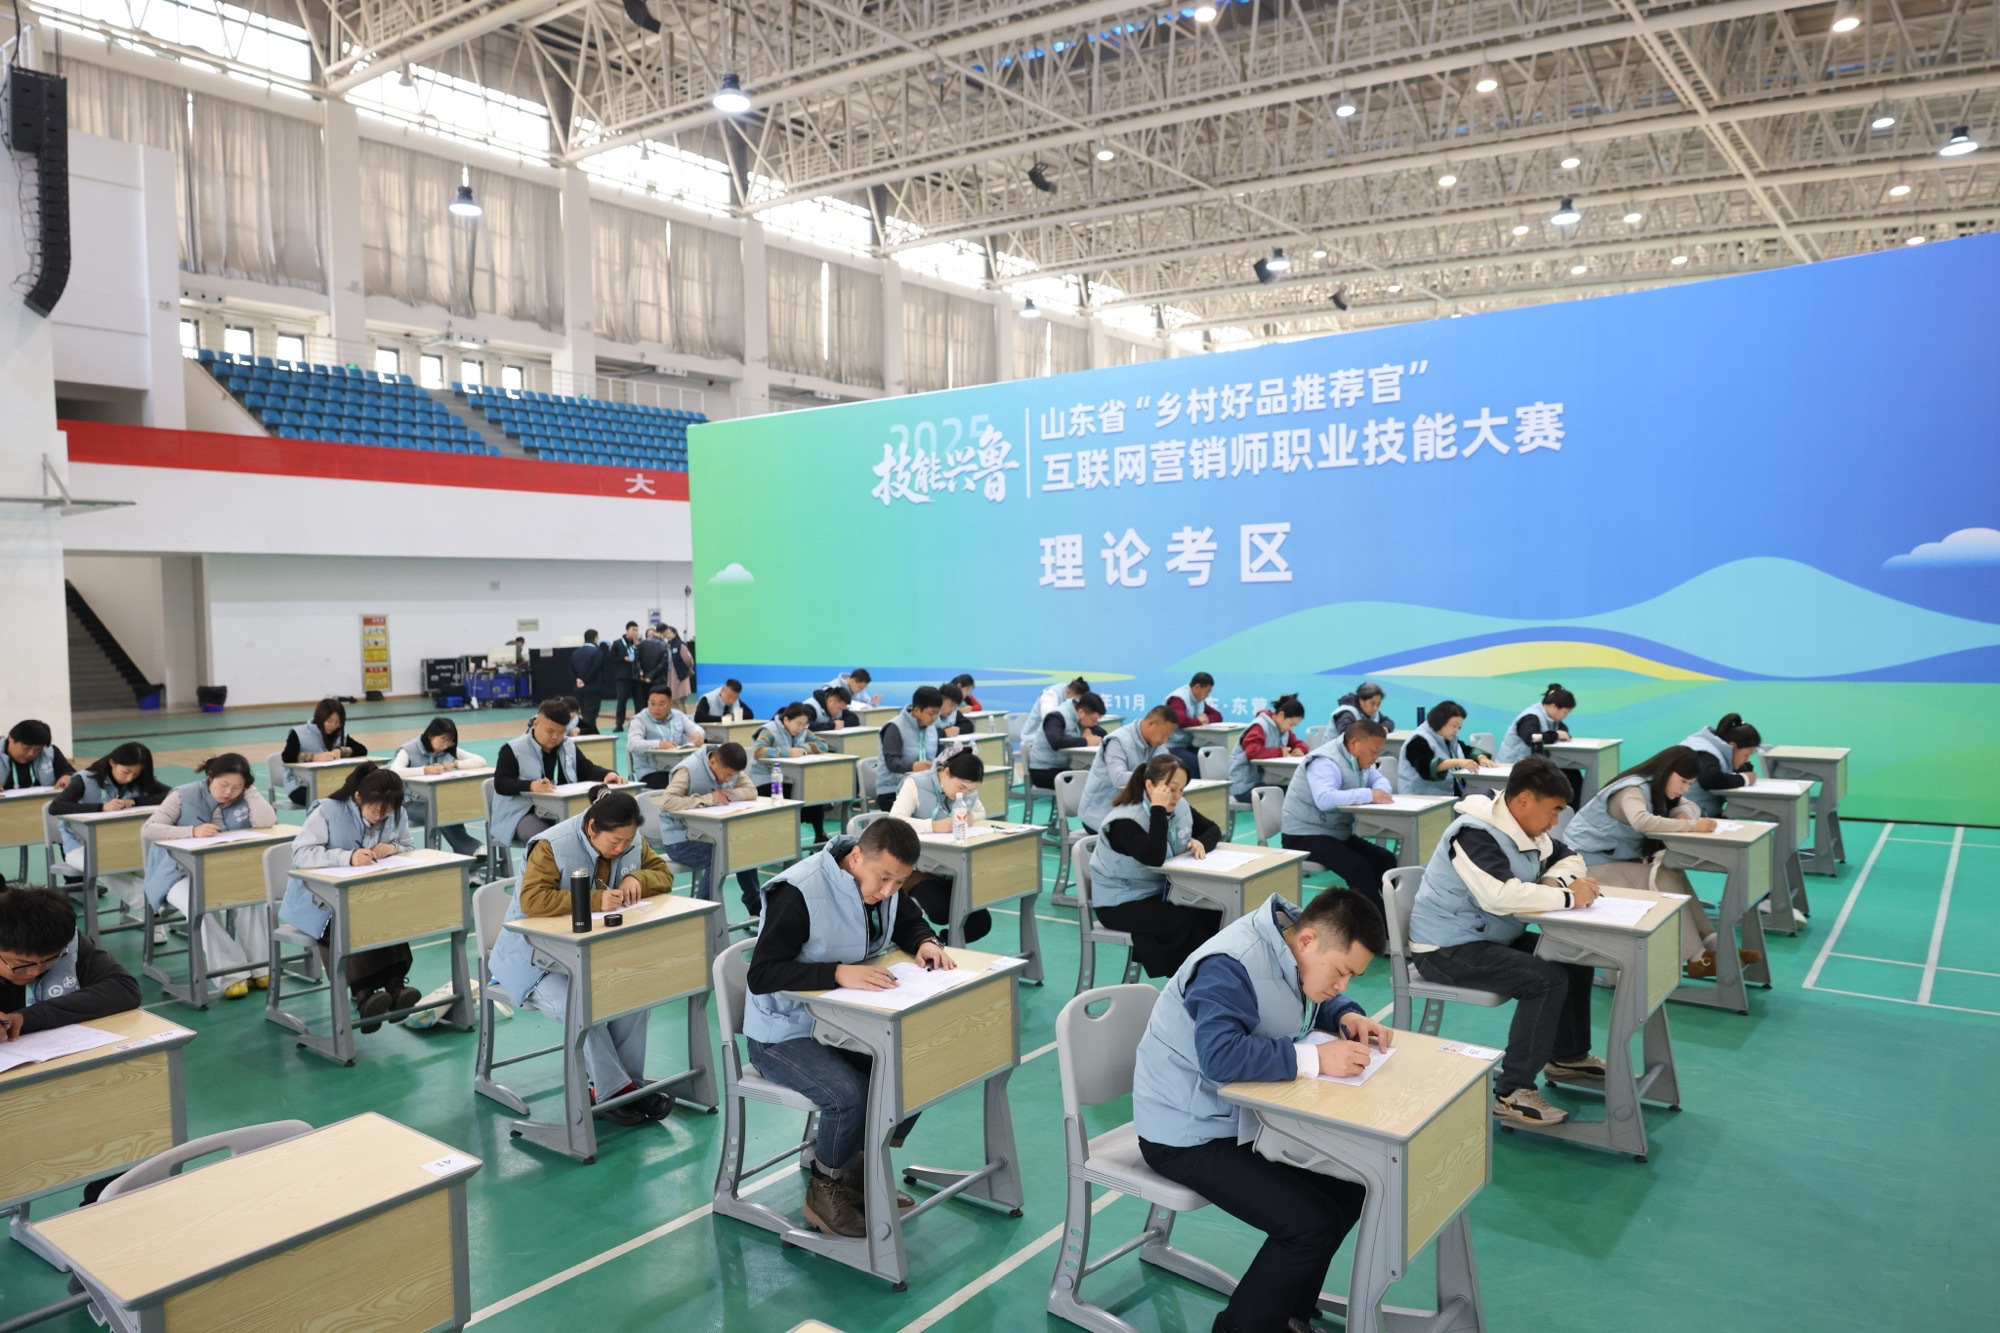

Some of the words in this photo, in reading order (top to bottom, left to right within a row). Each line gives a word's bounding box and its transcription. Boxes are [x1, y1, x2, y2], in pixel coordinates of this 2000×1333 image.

[871, 424, 1020, 506] 技能兴鲁
[1042, 401, 1566, 492] 互联网营销师职业技能大赛
[625, 473, 656, 495] 大
[1039, 522, 1293, 588] 理论考区
